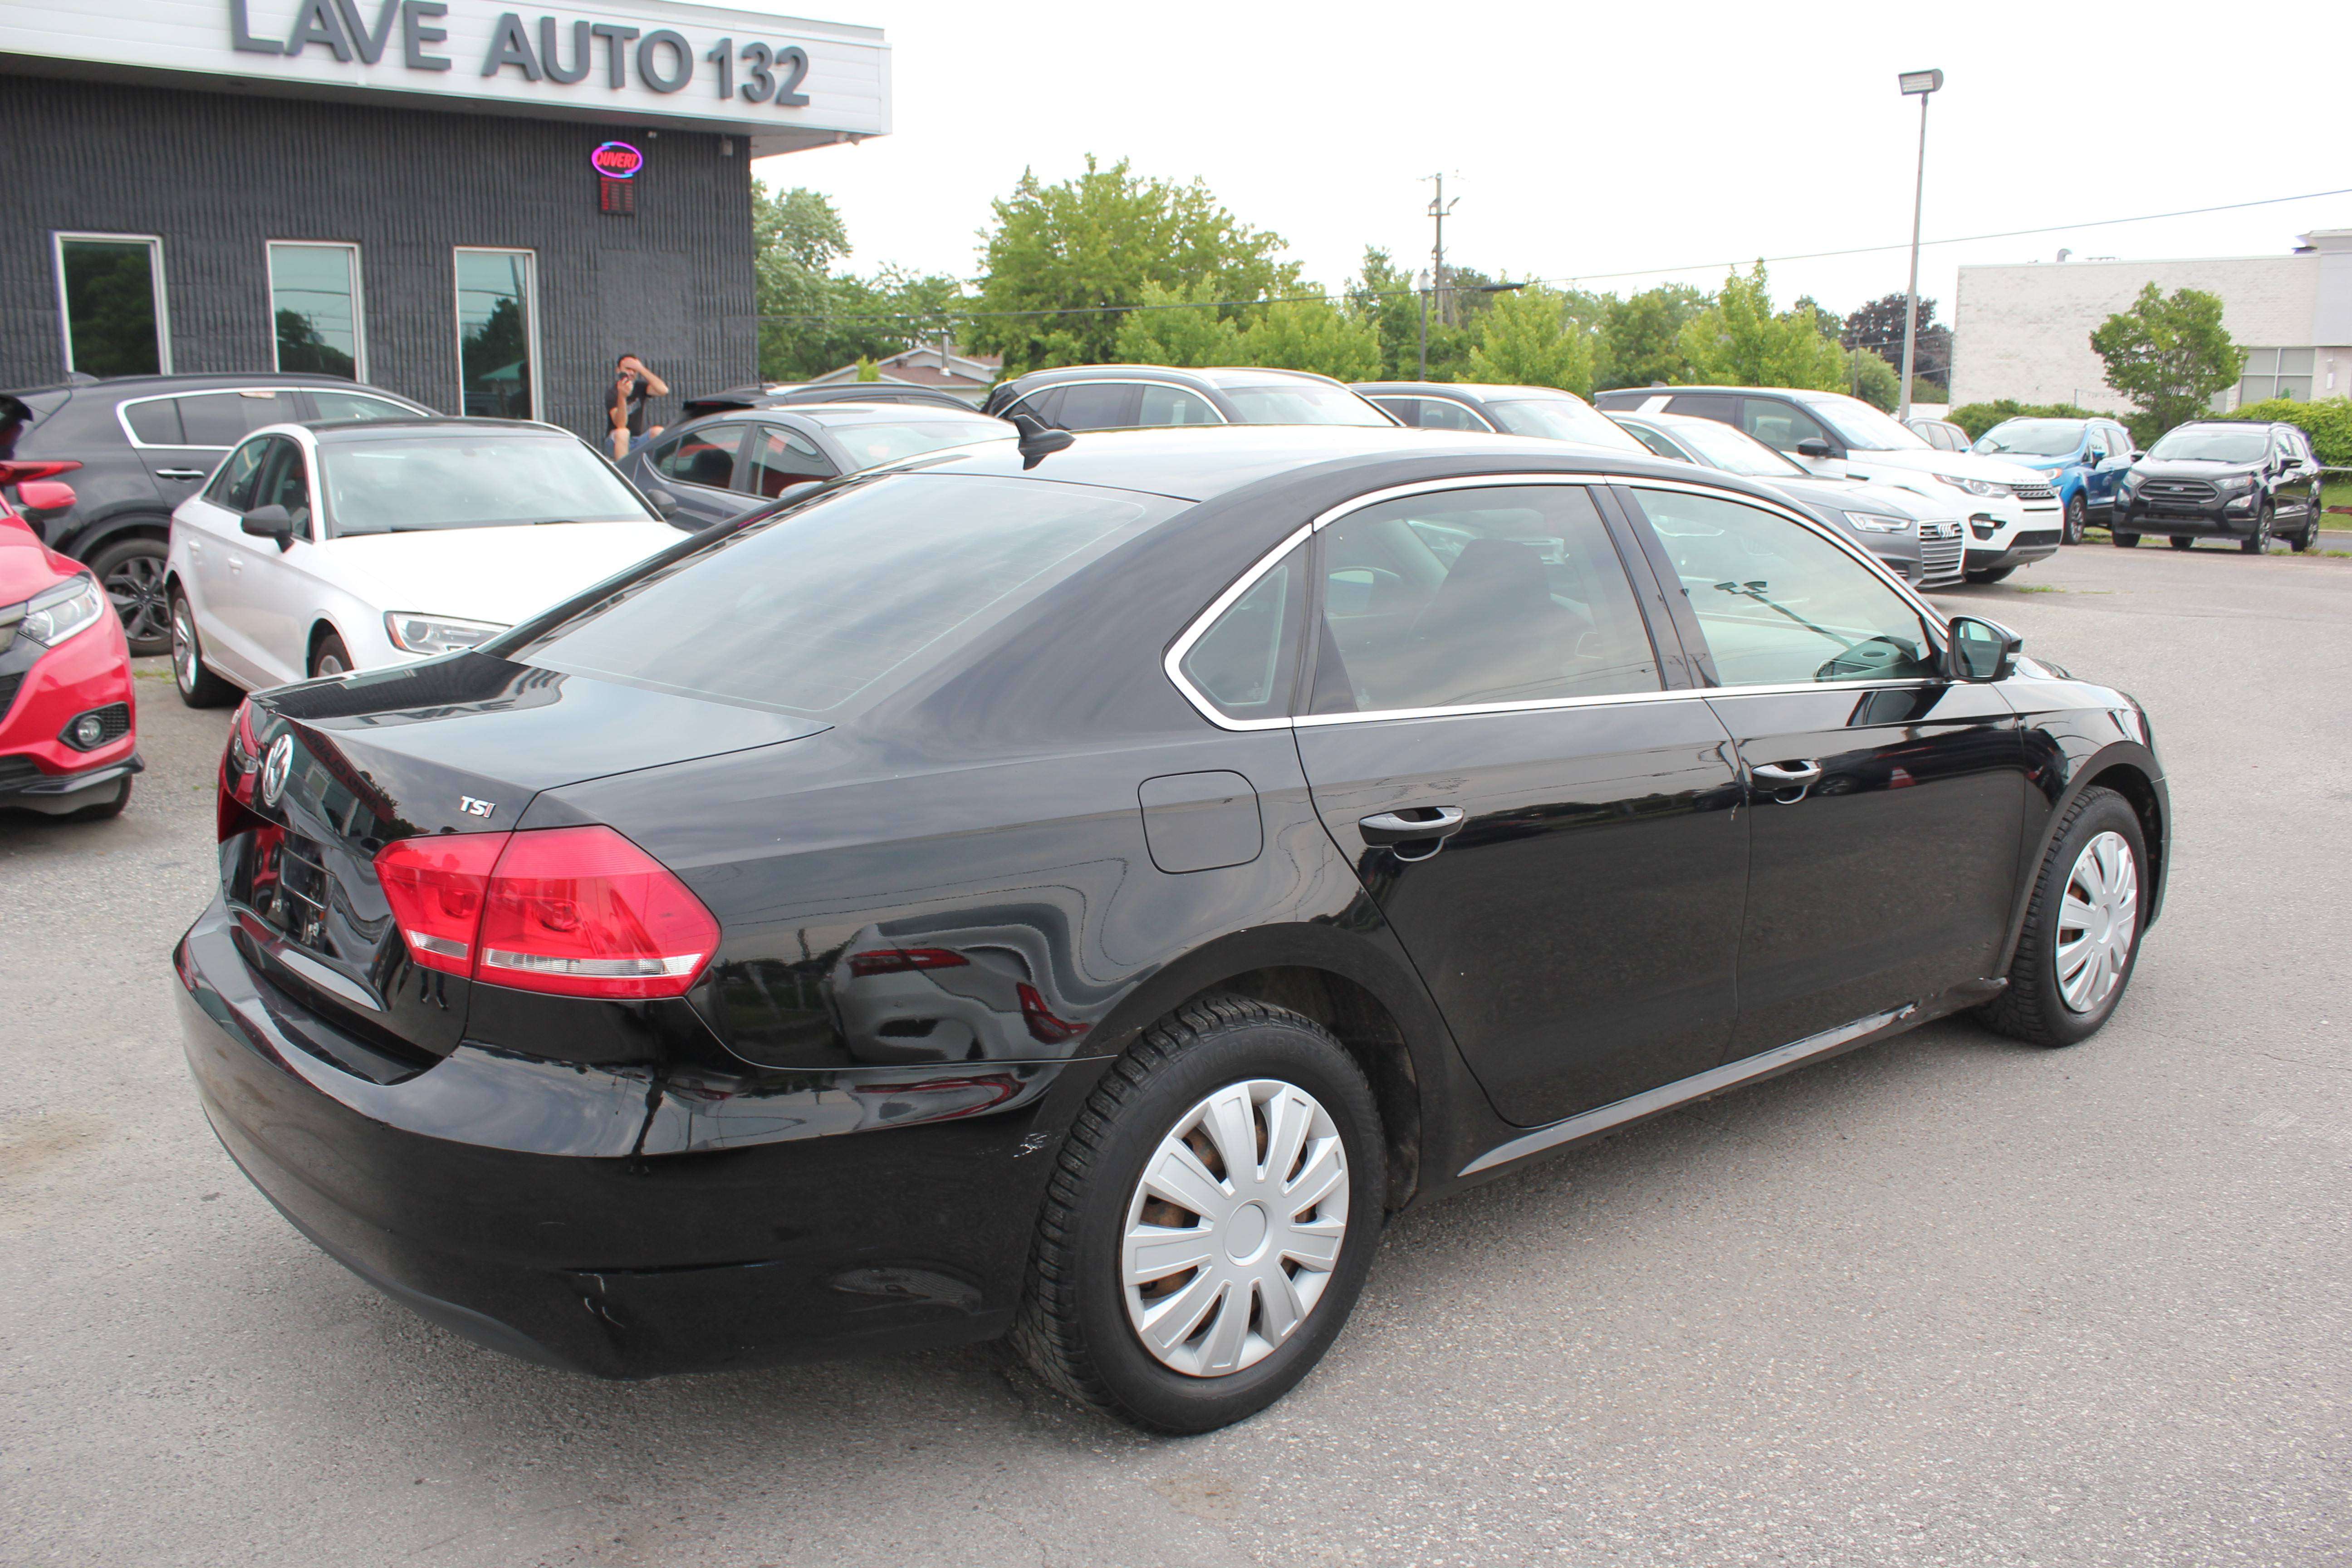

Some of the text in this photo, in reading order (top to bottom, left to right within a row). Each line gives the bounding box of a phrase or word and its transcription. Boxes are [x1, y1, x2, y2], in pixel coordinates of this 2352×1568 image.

[232, 0, 810, 107] LAVE AUTO 132
[597, 151, 638, 168] OUVERT
[460, 795, 497, 818] TSI
